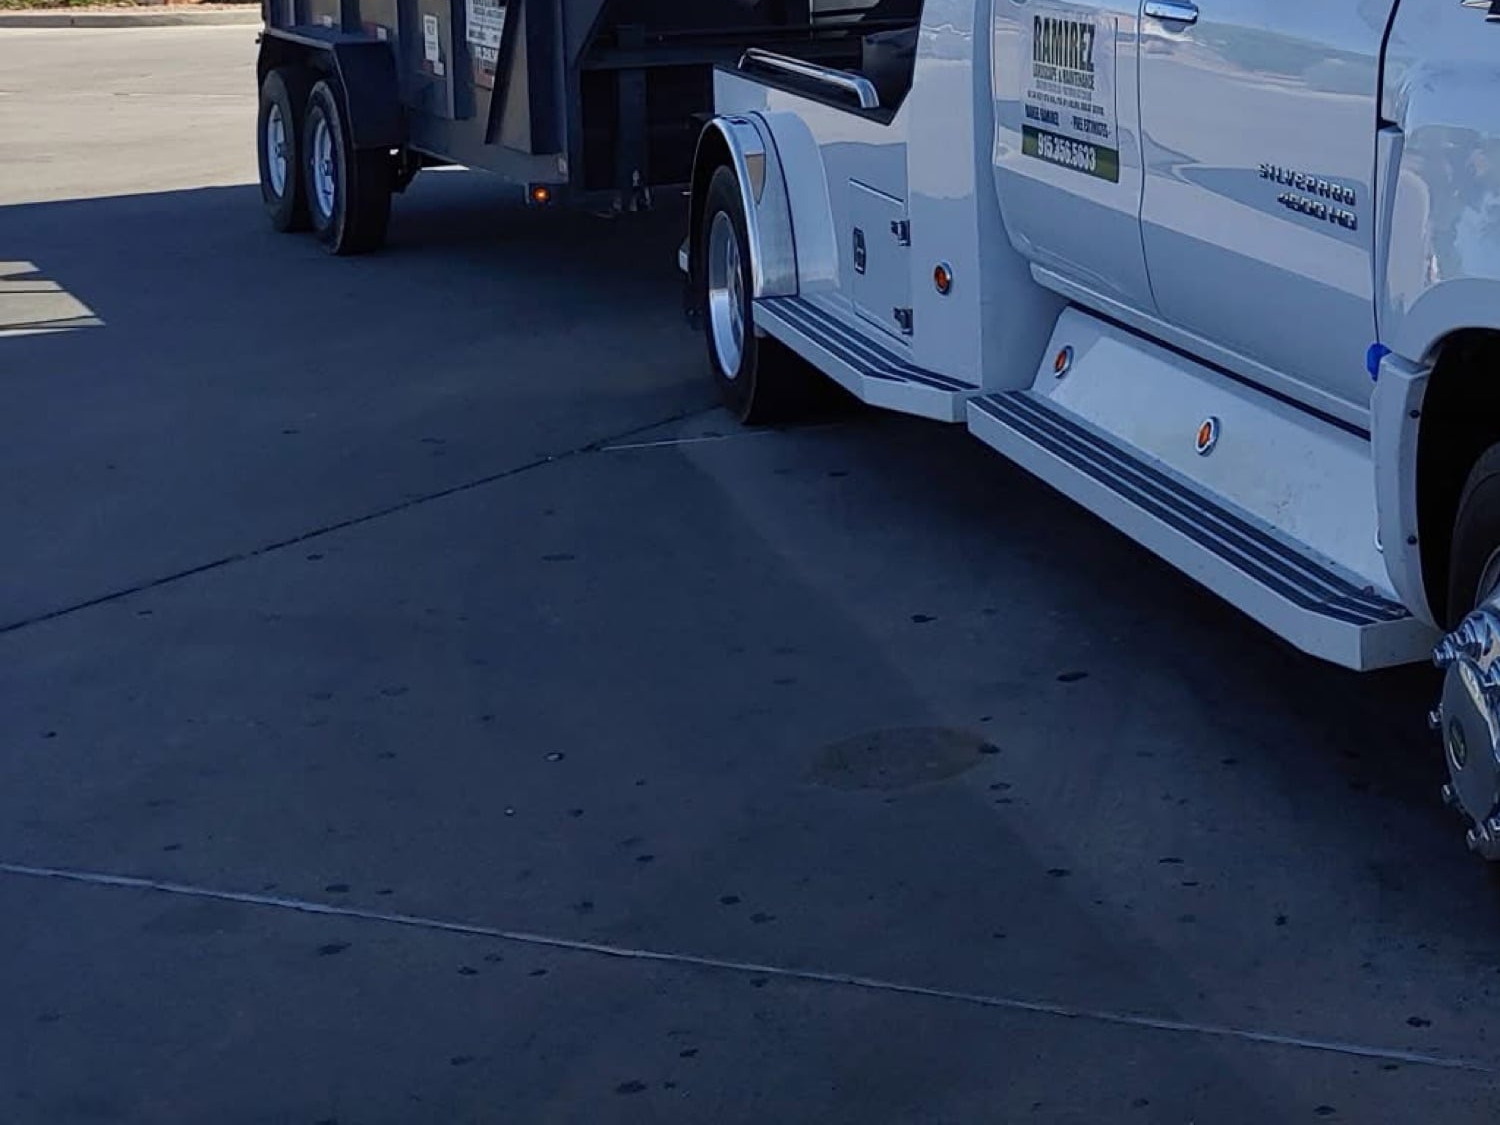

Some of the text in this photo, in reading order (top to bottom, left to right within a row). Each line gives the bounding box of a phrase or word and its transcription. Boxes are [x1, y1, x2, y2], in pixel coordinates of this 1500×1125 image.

[1033, 15, 1096, 72] RAMIREZ
[1258, 163, 1356, 206] SILVERADO
[1328, 206, 1358, 231] HD
